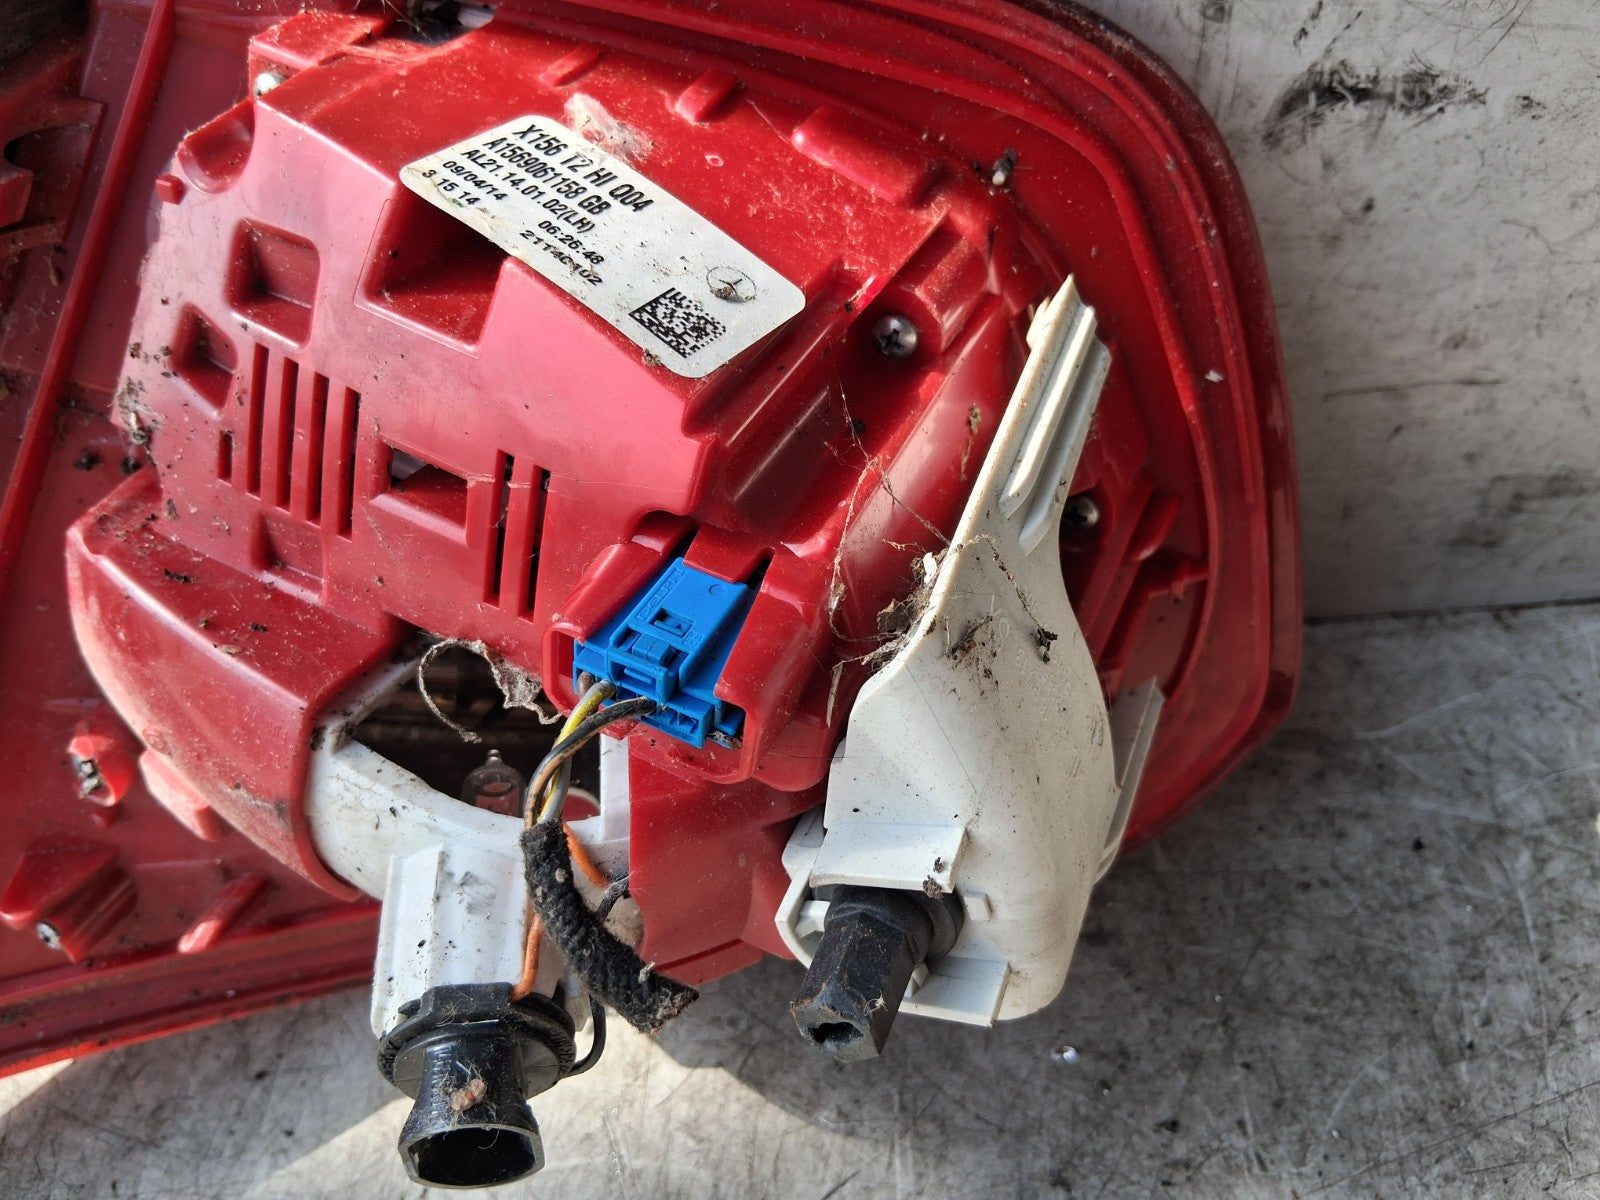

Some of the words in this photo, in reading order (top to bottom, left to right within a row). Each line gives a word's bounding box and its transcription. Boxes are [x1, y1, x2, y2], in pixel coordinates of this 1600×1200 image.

[422, 169, 437, 179] 3
[437, 178, 459, 192] 15
[458, 191, 480, 205] 14
[460, 149, 596, 234] AL21.14.01.02(LH)
[482, 137, 587, 199] A1569061158
[578, 195, 611, 215] GB
[512, 124, 568, 156] X156
[560, 153, 593, 173] T2
[583, 168, 618, 187] HI
[609, 184, 654, 212] Q04
[442, 160, 508, 200] 09/04/14
[538, 220, 604, 265] 06:26:48
